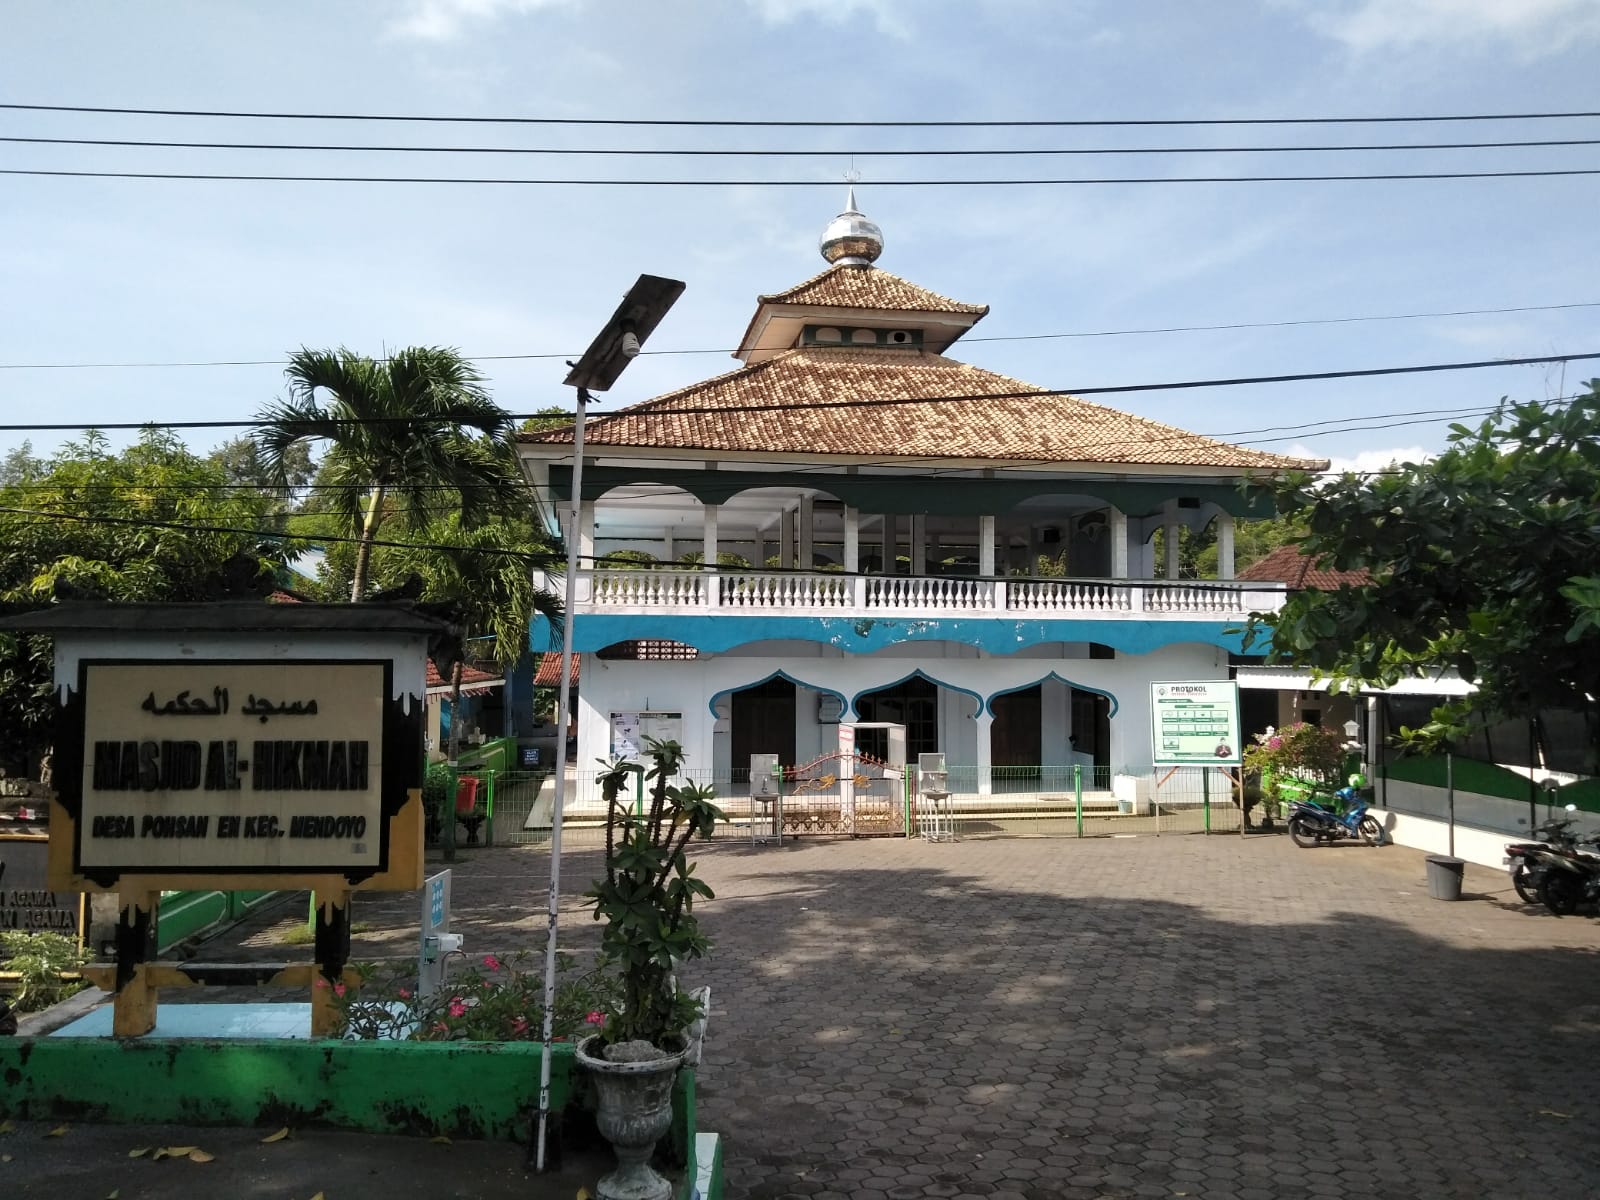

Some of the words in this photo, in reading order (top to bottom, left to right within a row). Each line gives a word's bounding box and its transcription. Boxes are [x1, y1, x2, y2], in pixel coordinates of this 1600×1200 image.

[241, 693, 318, 724] مسجد
[92, 740, 202, 792] MASJID
[92, 815, 135, 838] DESA
[244, 815, 285, 838] KEC.
[289, 815, 367, 838] MENDOYO
[9, 890, 57, 907] AGAMA
[24, 909, 76, 928] AGAMA
